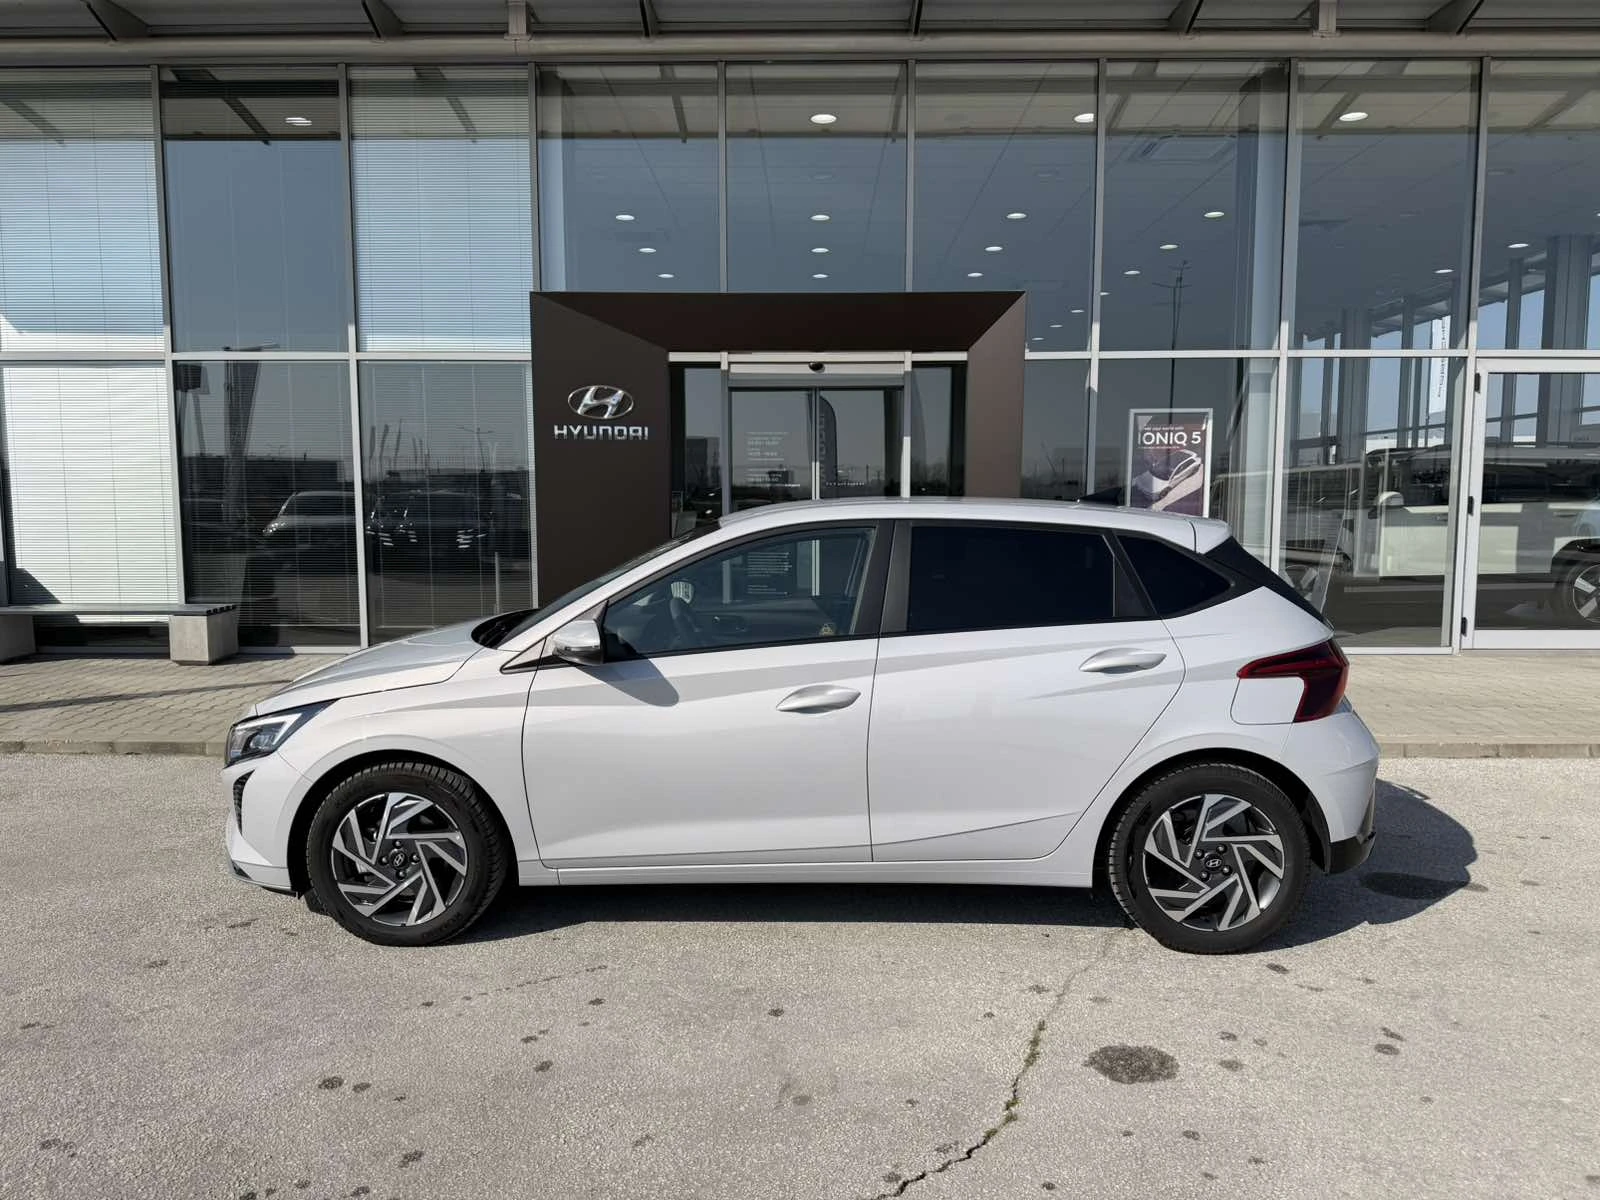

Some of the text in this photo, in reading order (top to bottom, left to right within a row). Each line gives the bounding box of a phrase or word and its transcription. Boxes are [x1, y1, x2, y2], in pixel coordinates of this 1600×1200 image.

[553, 425, 649, 440] HYUNDAI
[1138, 431, 1202, 446] IONIQ 5
